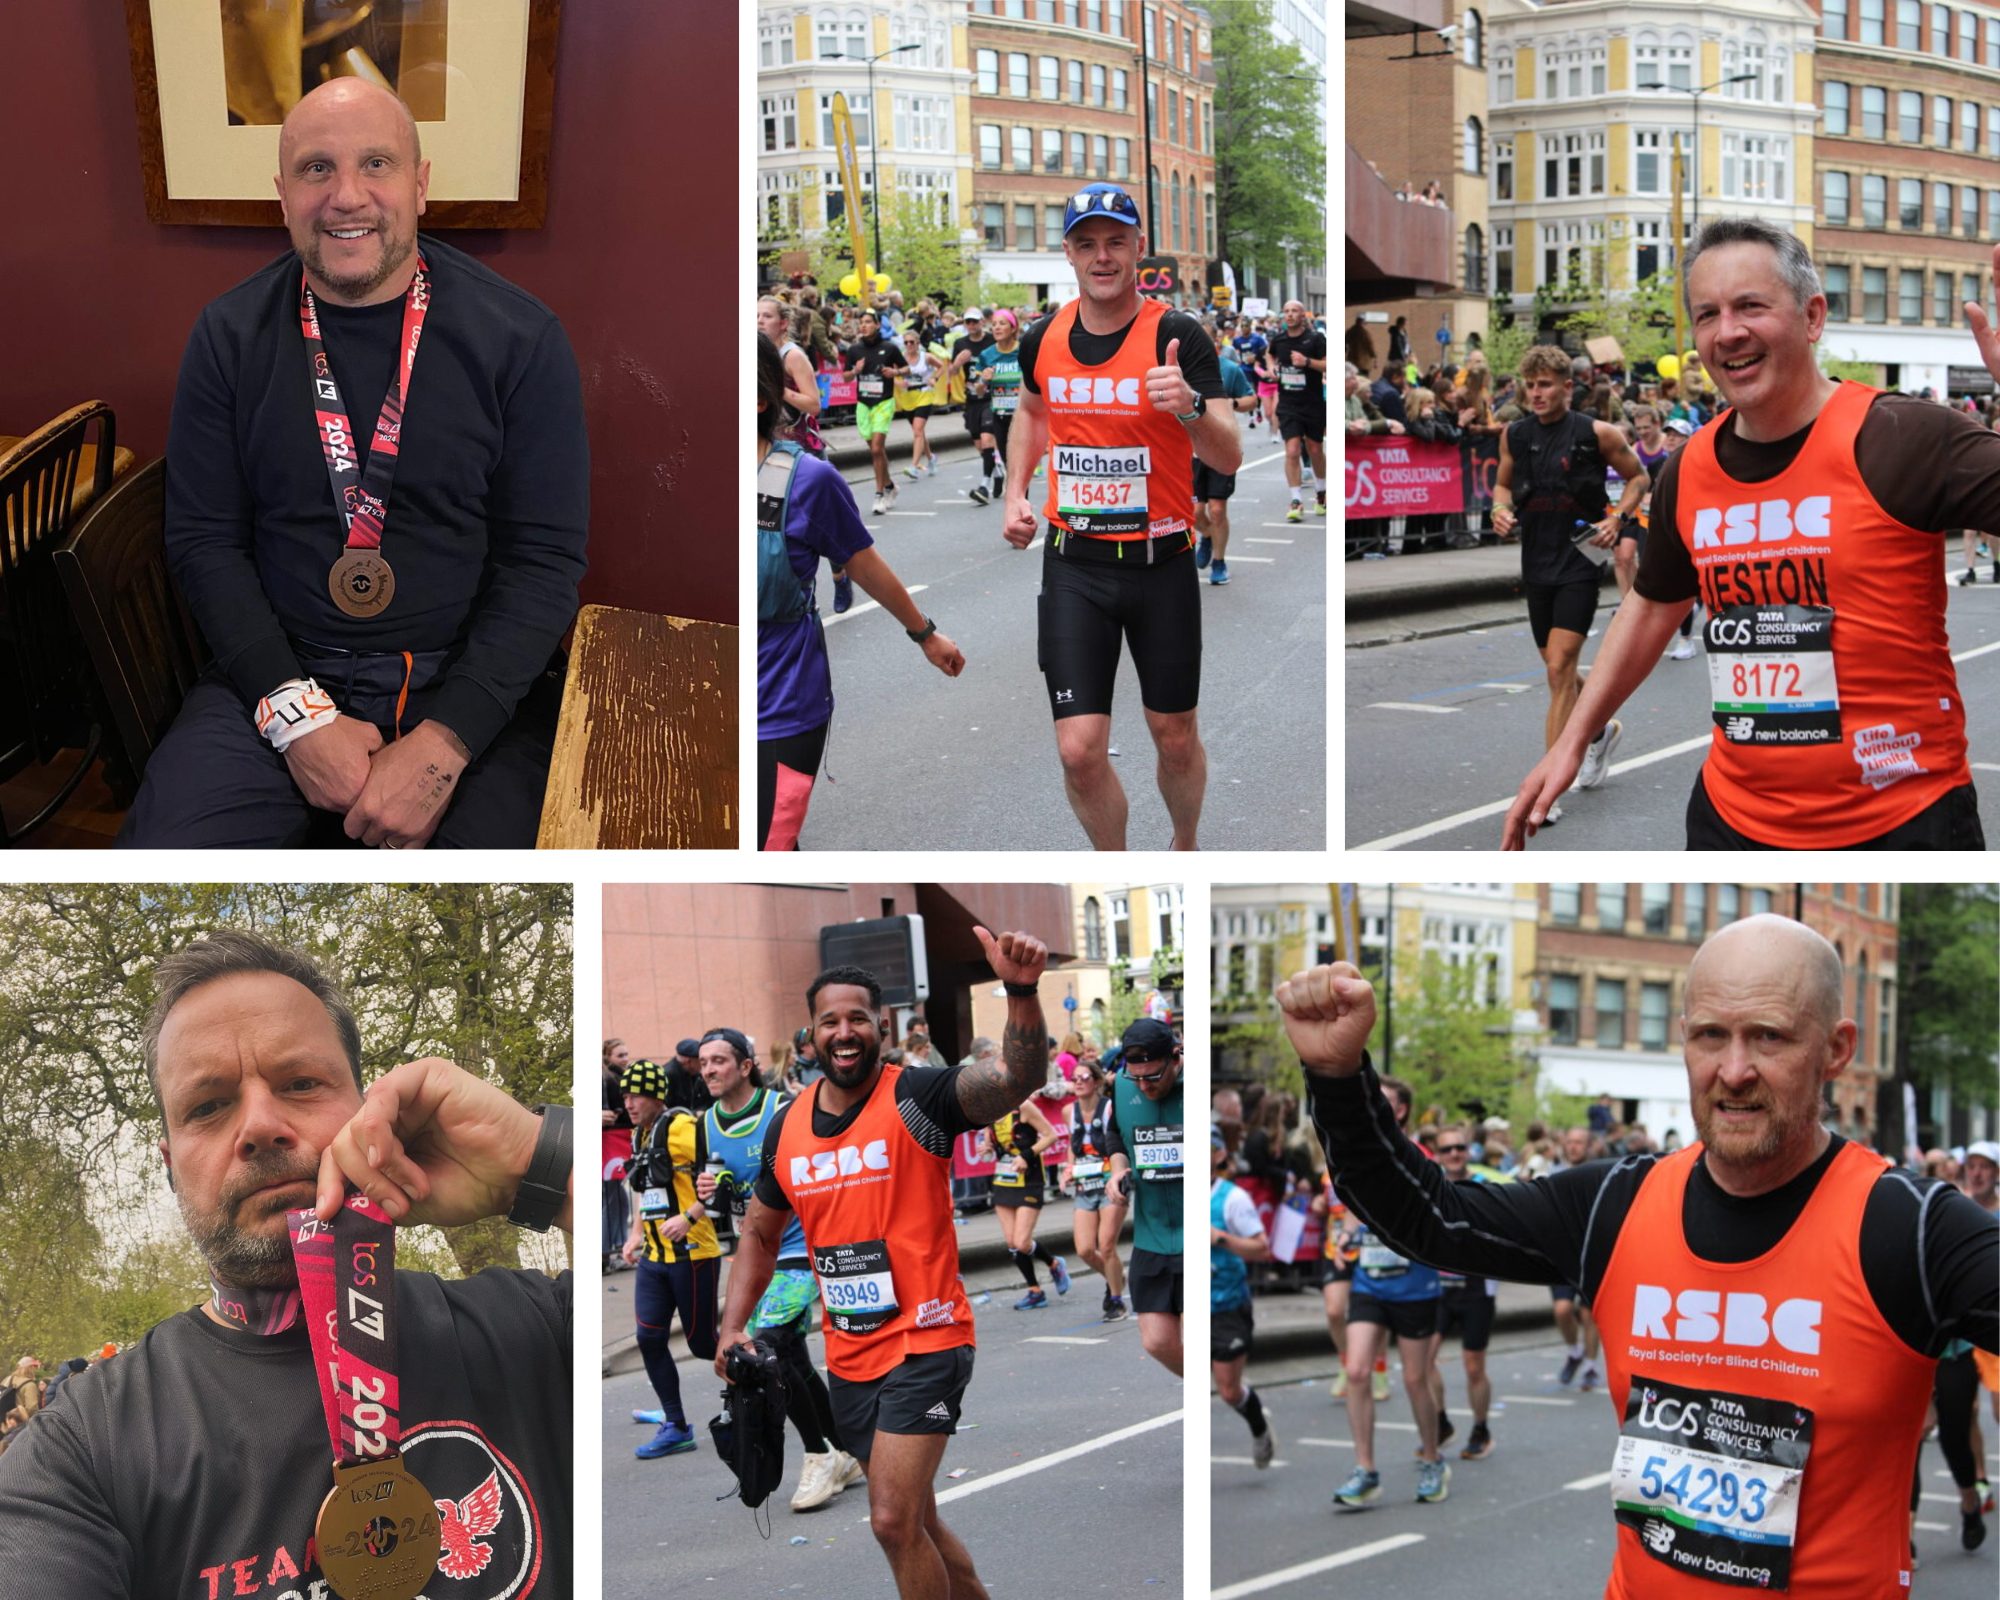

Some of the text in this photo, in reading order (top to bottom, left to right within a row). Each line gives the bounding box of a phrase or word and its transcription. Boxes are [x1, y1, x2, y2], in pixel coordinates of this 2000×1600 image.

[1048, 377, 1139, 406] RSBC
[1064, 407, 1085, 415] Society
[1111, 409, 1139, 417] Children
[325, 418, 353, 472] 2024
[378, 434, 396, 442] 2024
[1059, 451, 1147, 473] Michael
[1377, 448, 1410, 463] TATA
[1379, 467, 1451, 484] CONSULTANCY
[364, 495, 382, 506] 2024
[1072, 483, 1132, 505] 15437
[1381, 488, 1429, 504] SERVICES
[1090, 523, 1106, 531] new
[1107, 521, 1140, 531] balance
[1694, 496, 1831, 550] RSBC
[1713, 552, 1746, 563] Society
[1747, 550, 1759, 559] for
[1761, 549, 1785, 558] Blind
[1787, 546, 1830, 555] Children
[1756, 612, 1784, 621] TATA
[1710, 618, 1751, 645] tcs
[1756, 622, 1822, 633] CONSULTANCY
[1756, 635, 1797, 645] SERVICES
[1733, 663, 1803, 697] 8172
[1756, 731, 1778, 740] new
[1780, 729, 1829, 741] balance
[1862, 730, 1889, 743] Life
[1858, 735, 1916, 759] Without
[1867, 752, 1909, 772] Limits
[1135, 1128, 1154, 1142] tcs
[790, 1139, 890, 1187] RSBC
[1142, 1148, 1179, 1162] 59709
[809, 1184, 832, 1194] Society
[844, 1179, 860, 1187] Blind
[862, 1174, 892, 1185] Children
[836, 1249, 854, 1258] TATA
[837, 1253, 881, 1265] CONSULTANCY
[353, 1242, 381, 1286] tcs
[839, 1262, 867, 1273] SERVICES
[827, 1281, 880, 1306] 53949
[1631, 1284, 1822, 1356] RSBC
[1629, 1346, 1819, 1377] Royal Society for Blind Children
[352, 1376, 387, 1458] 202
[1710, 1398, 1745, 1417] TATA
[1707, 1413, 1799, 1441] CONSULTANCY
[1703, 1427, 1762, 1452] SERVICES
[351, 1488, 373, 1504] tcs
[1639, 1456, 1767, 1522] 54293
[1673, 1549, 1702, 1567] new
[1705, 1555, 1771, 1580] balance
